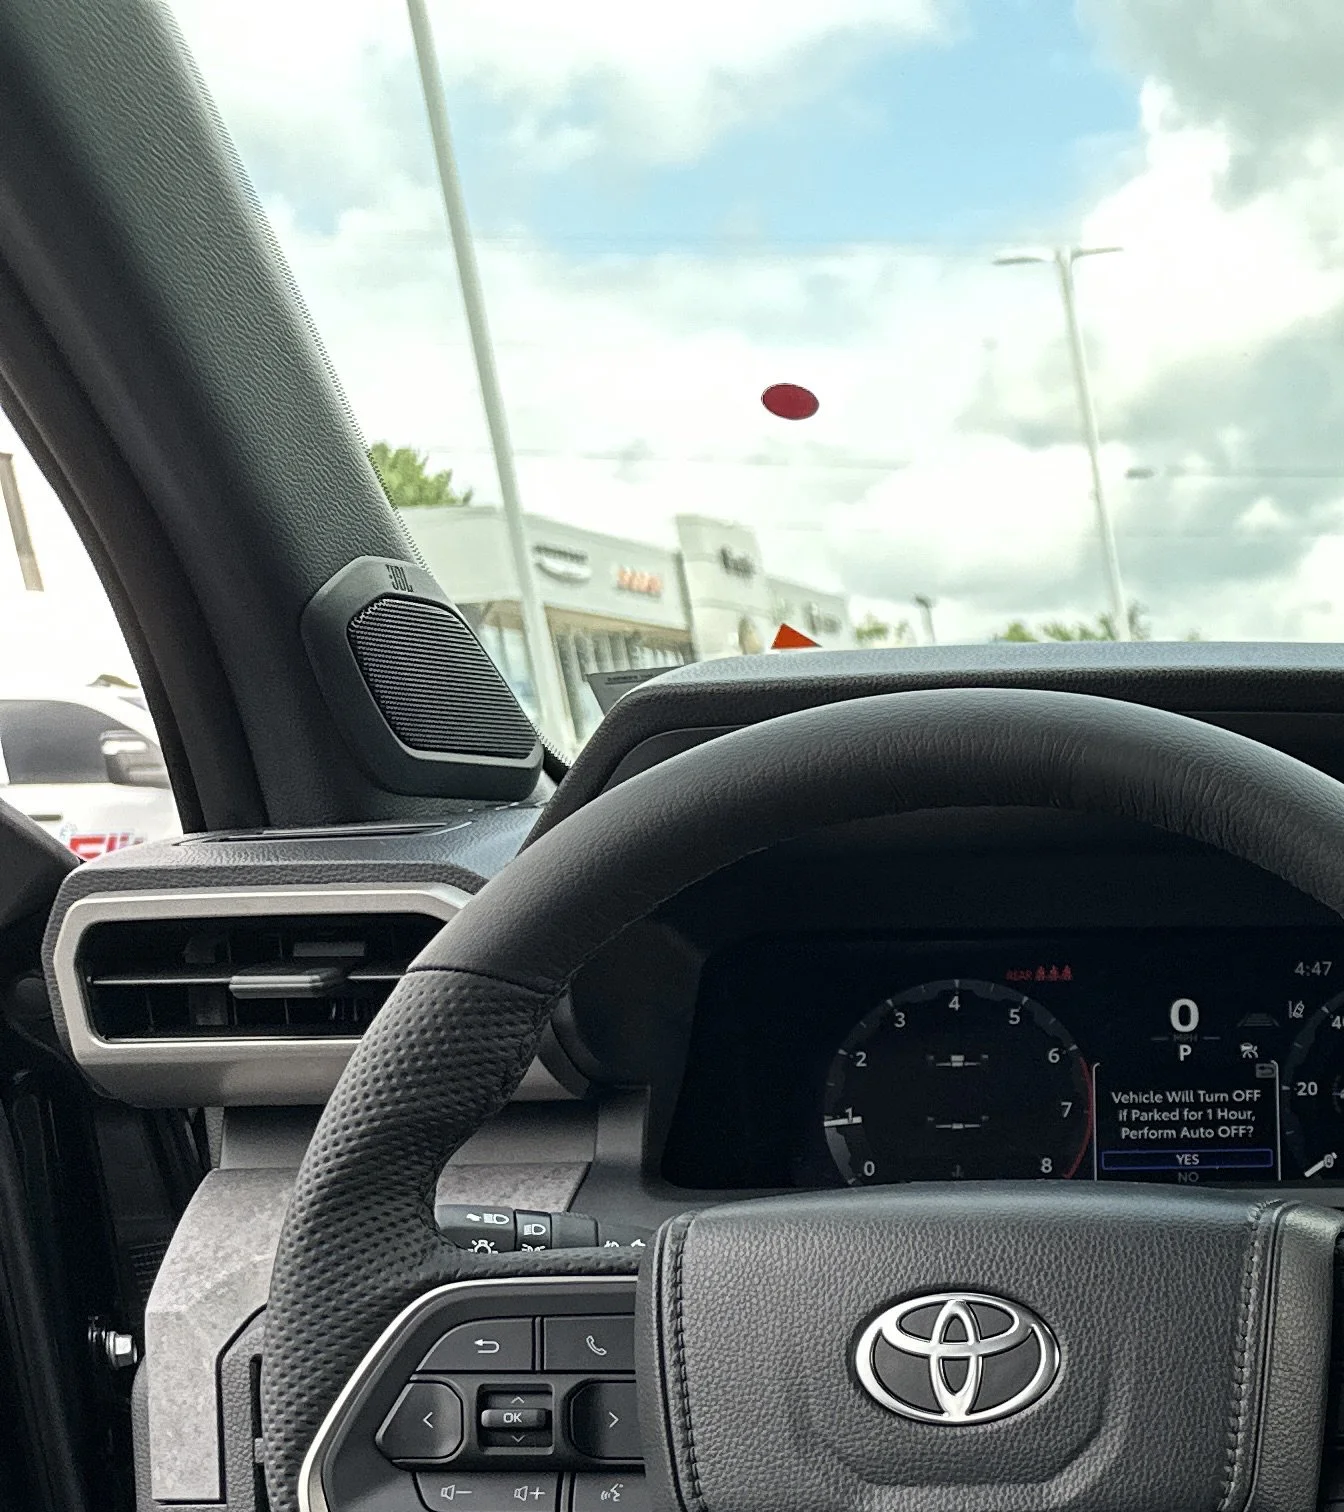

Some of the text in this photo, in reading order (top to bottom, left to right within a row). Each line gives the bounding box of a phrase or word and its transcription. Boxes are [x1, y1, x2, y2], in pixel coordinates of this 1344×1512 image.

[385, 564, 414, 592] JBL
[1294, 961, 1332, 976] 4:47
[949, 996, 960, 1010] 4
[894, 1012, 905, 1027] 3
[1009, 1009, 1020, 1024] 5
[1170, 998, 1199, 1033] 0
[856, 1052, 867, 1067] 2
[1048, 1048, 1060, 1063] 6
[1179, 1044, 1192, 1061] P
[1297, 1082, 1318, 1096] 20
[1112, 1090, 1261, 1104] Vehicle Will Turn OFF
[1060, 1102, 1072, 1118] 7
[1132, 1108, 1179, 1121] Parked
[1183, 1108, 1203, 1121] for
[1207, 1109, 1213, 1120] 1
[1217, 1108, 1255, 1122] Hour,
[1121, 1126, 1254, 1139] Perform Auto OFF?
[1040, 1158, 1052, 1173] 8
[1176, 1154, 1199, 1166] YES
[863, 1161, 875, 1177] 0
[1178, 1171, 1199, 1183] NO
[503, 1412, 522, 1423] OK
